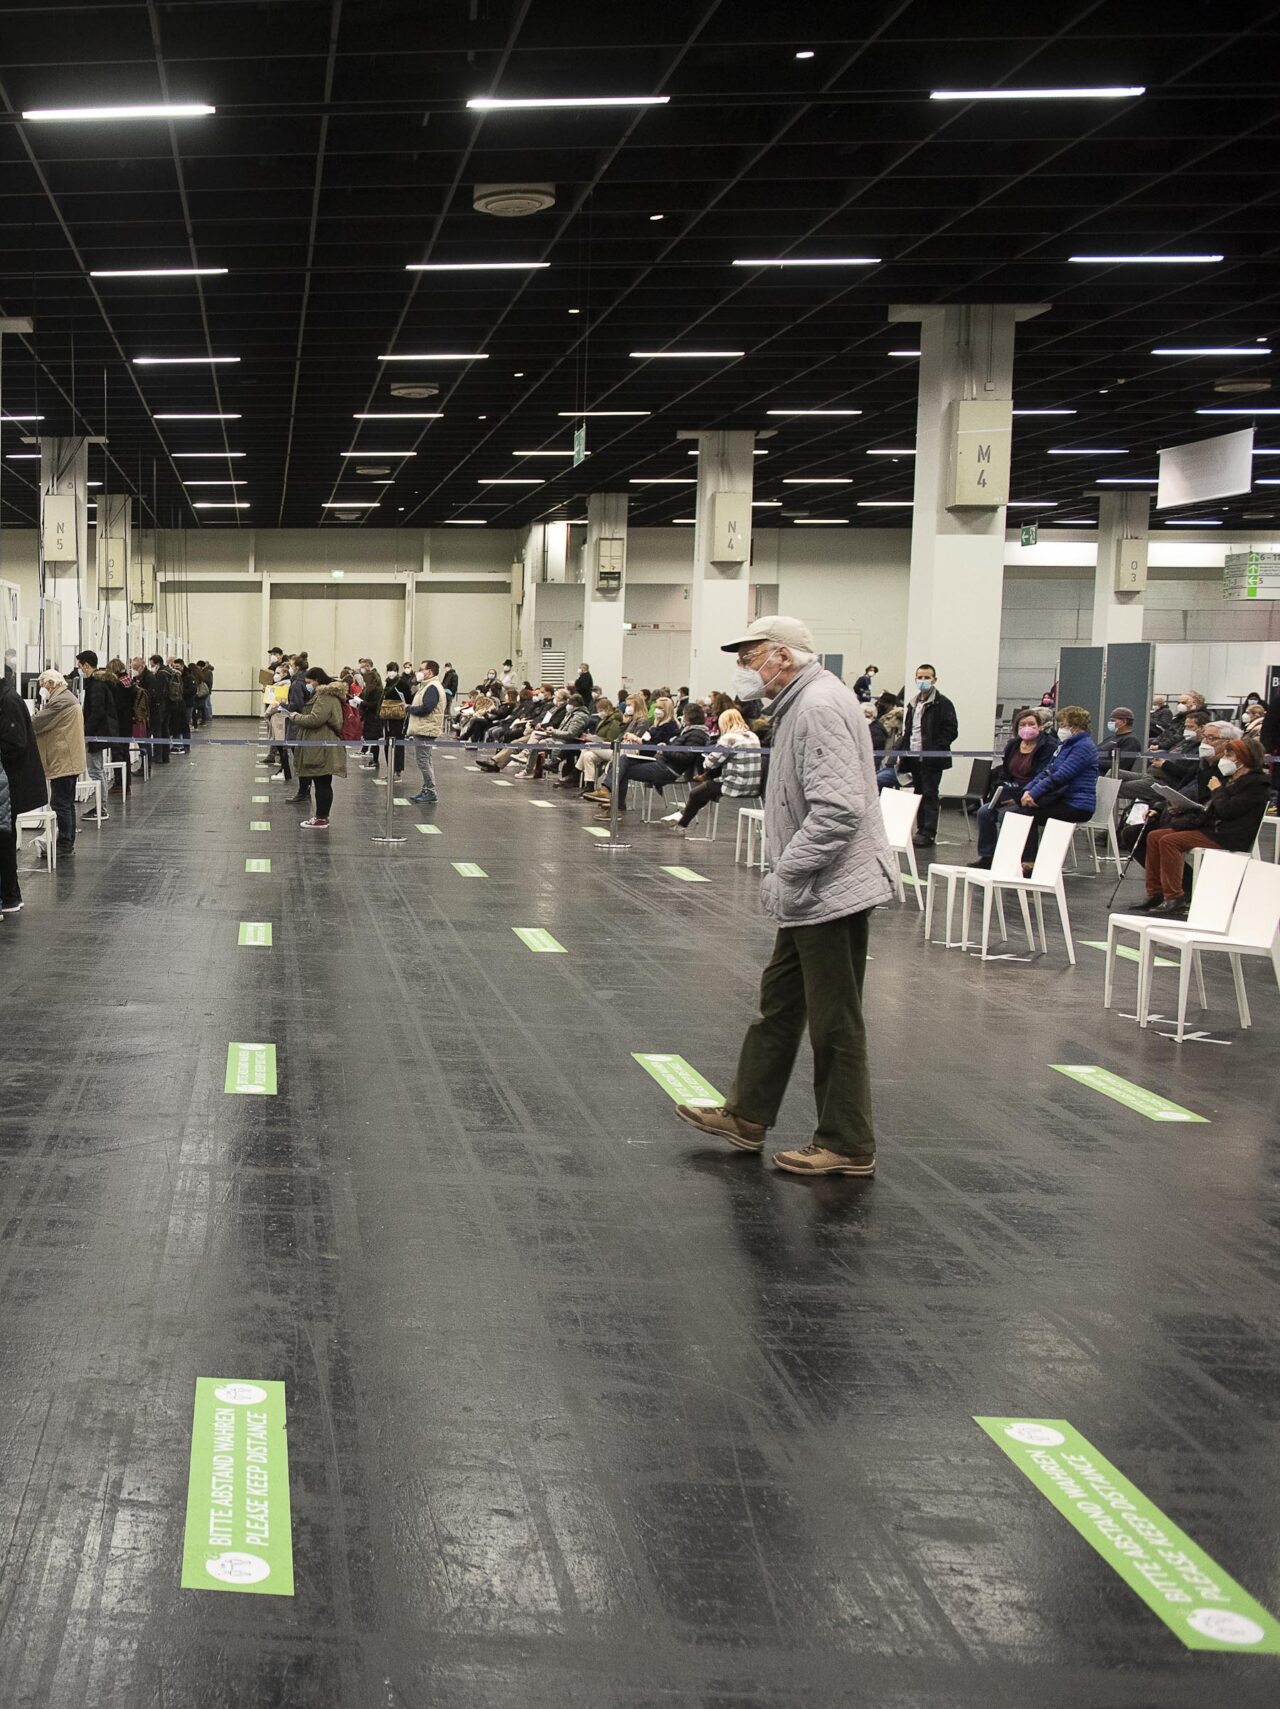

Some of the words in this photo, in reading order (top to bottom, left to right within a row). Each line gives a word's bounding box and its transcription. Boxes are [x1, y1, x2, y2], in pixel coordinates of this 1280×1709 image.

[977, 444, 991, 464] M
[976, 469, 987, 488] 4
[56, 522, 65, 534] N
[56, 538, 64, 551] 5
[727, 520, 737, 534] N
[727, 537, 735, 550] 4
[213, 1407, 235, 1452] WAHREN
[245, 1410, 268, 1463] DISTANCE
[210, 1454, 234, 1507] ABSTAND
[245, 1464, 268, 1497] KEEP
[1024, 1448, 1089, 1499] WAHREN
[1060, 1451, 1137, 1510] DISTANCE
[208, 1507, 233, 1546] BITTE
[245, 1498, 269, 1546] PLEASE
[1076, 1501, 1151, 1559] ABSTAND
[1121, 1512, 1175, 1547] KEEP
[1132, 1559, 1193, 1602] BITTE
[1156, 1548, 1231, 1602] PLEASE
